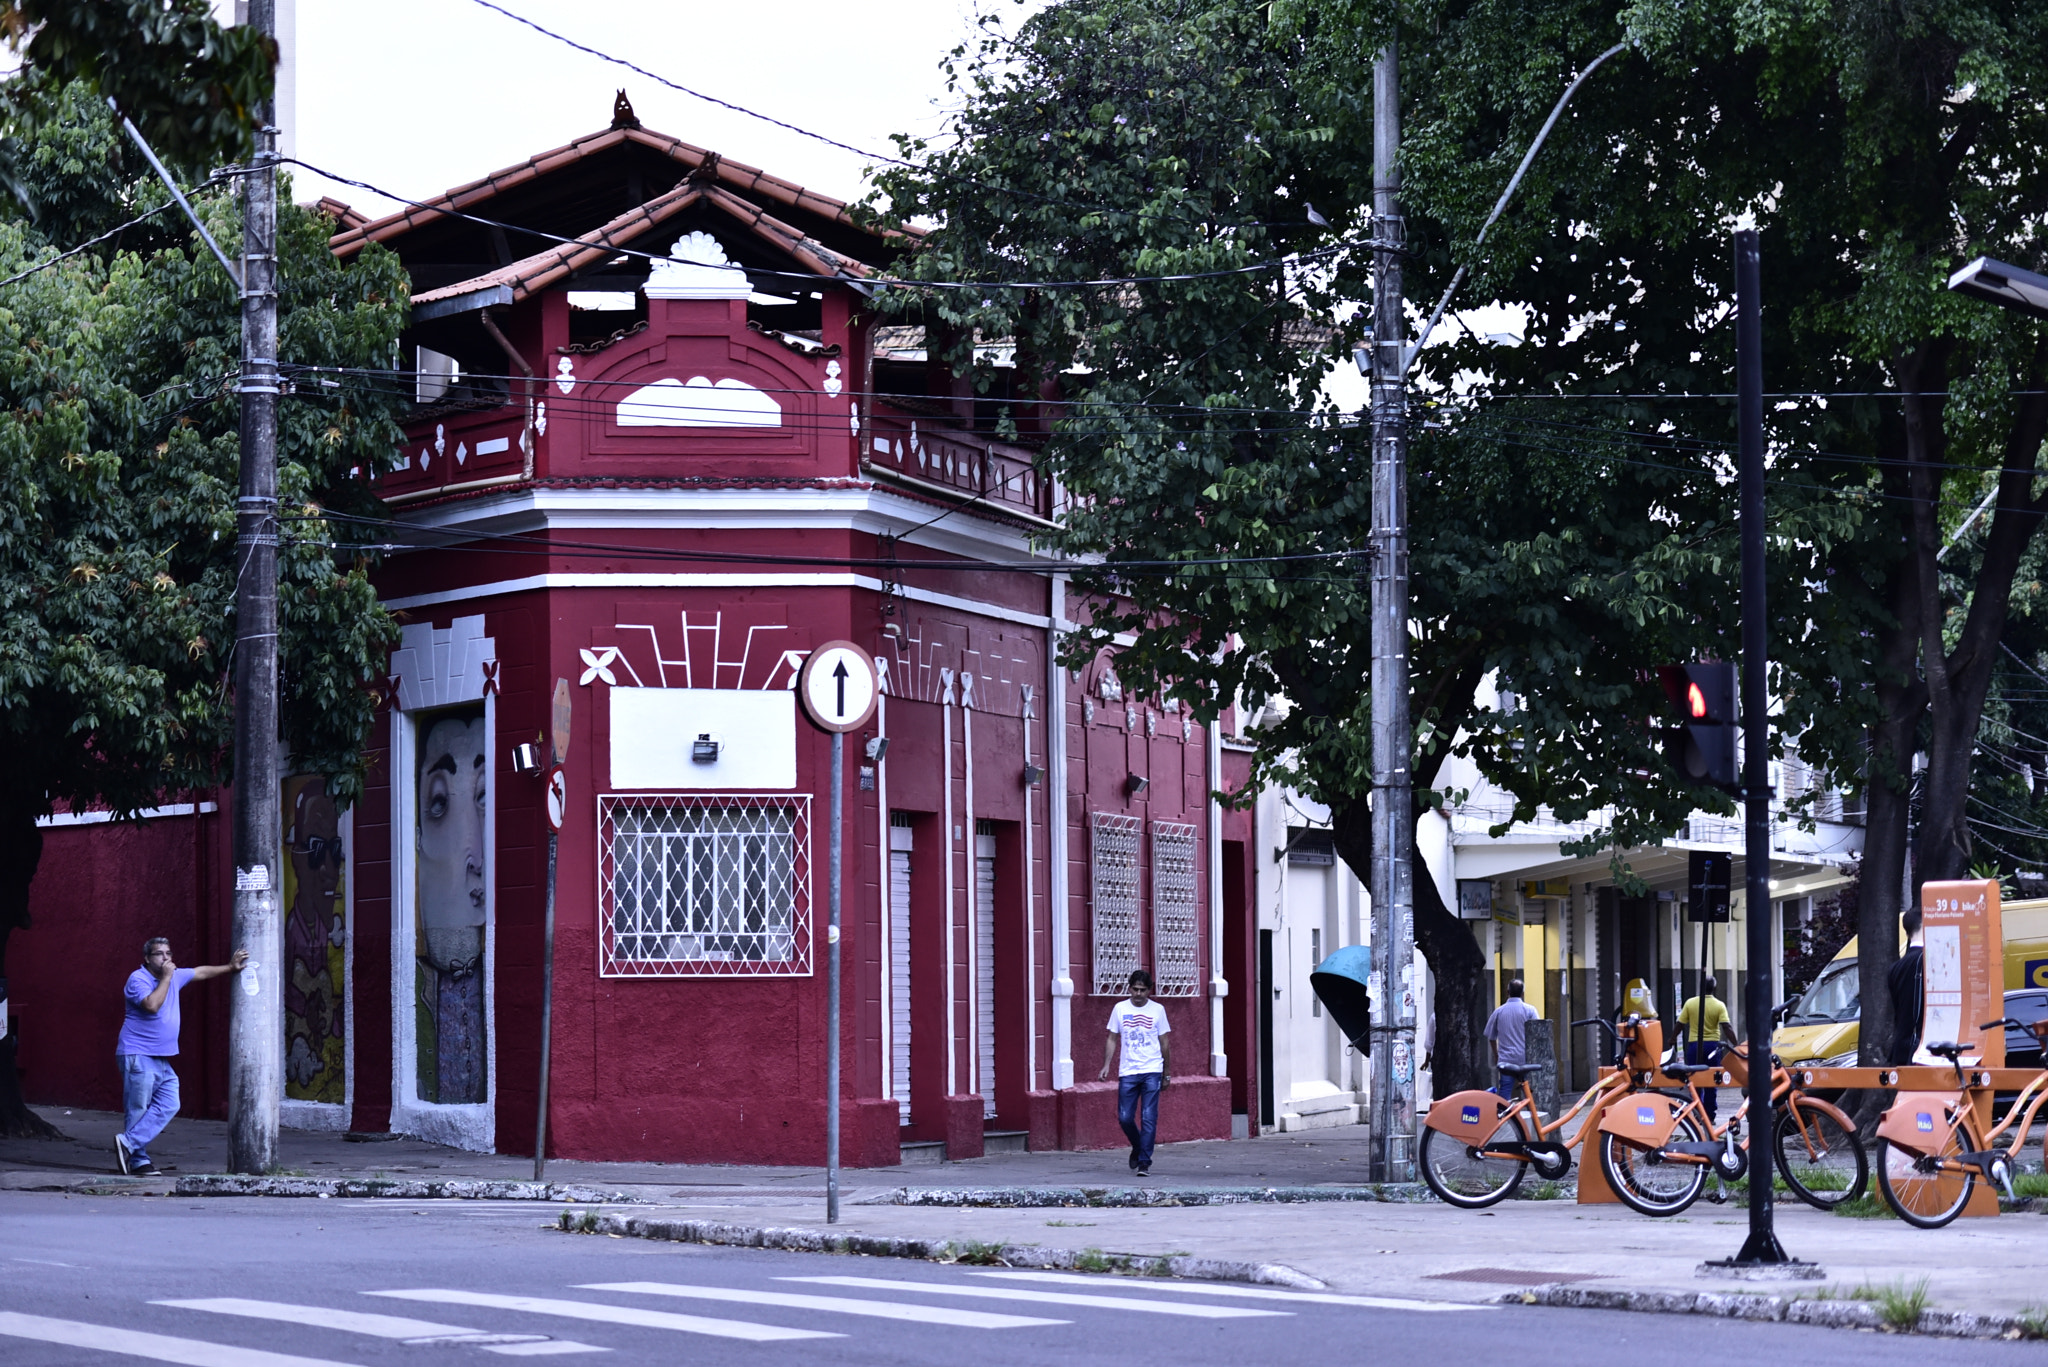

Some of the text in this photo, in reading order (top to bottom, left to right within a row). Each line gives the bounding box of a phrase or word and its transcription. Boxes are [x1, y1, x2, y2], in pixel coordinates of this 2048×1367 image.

[1936, 899, 1948, 912] 39
[1962, 901, 1975, 911] bike
[1462, 1114, 1478, 1122] Itaú
[1638, 1115, 1655, 1123] Itaú
[1917, 1121, 1932, 1130] Itaú
